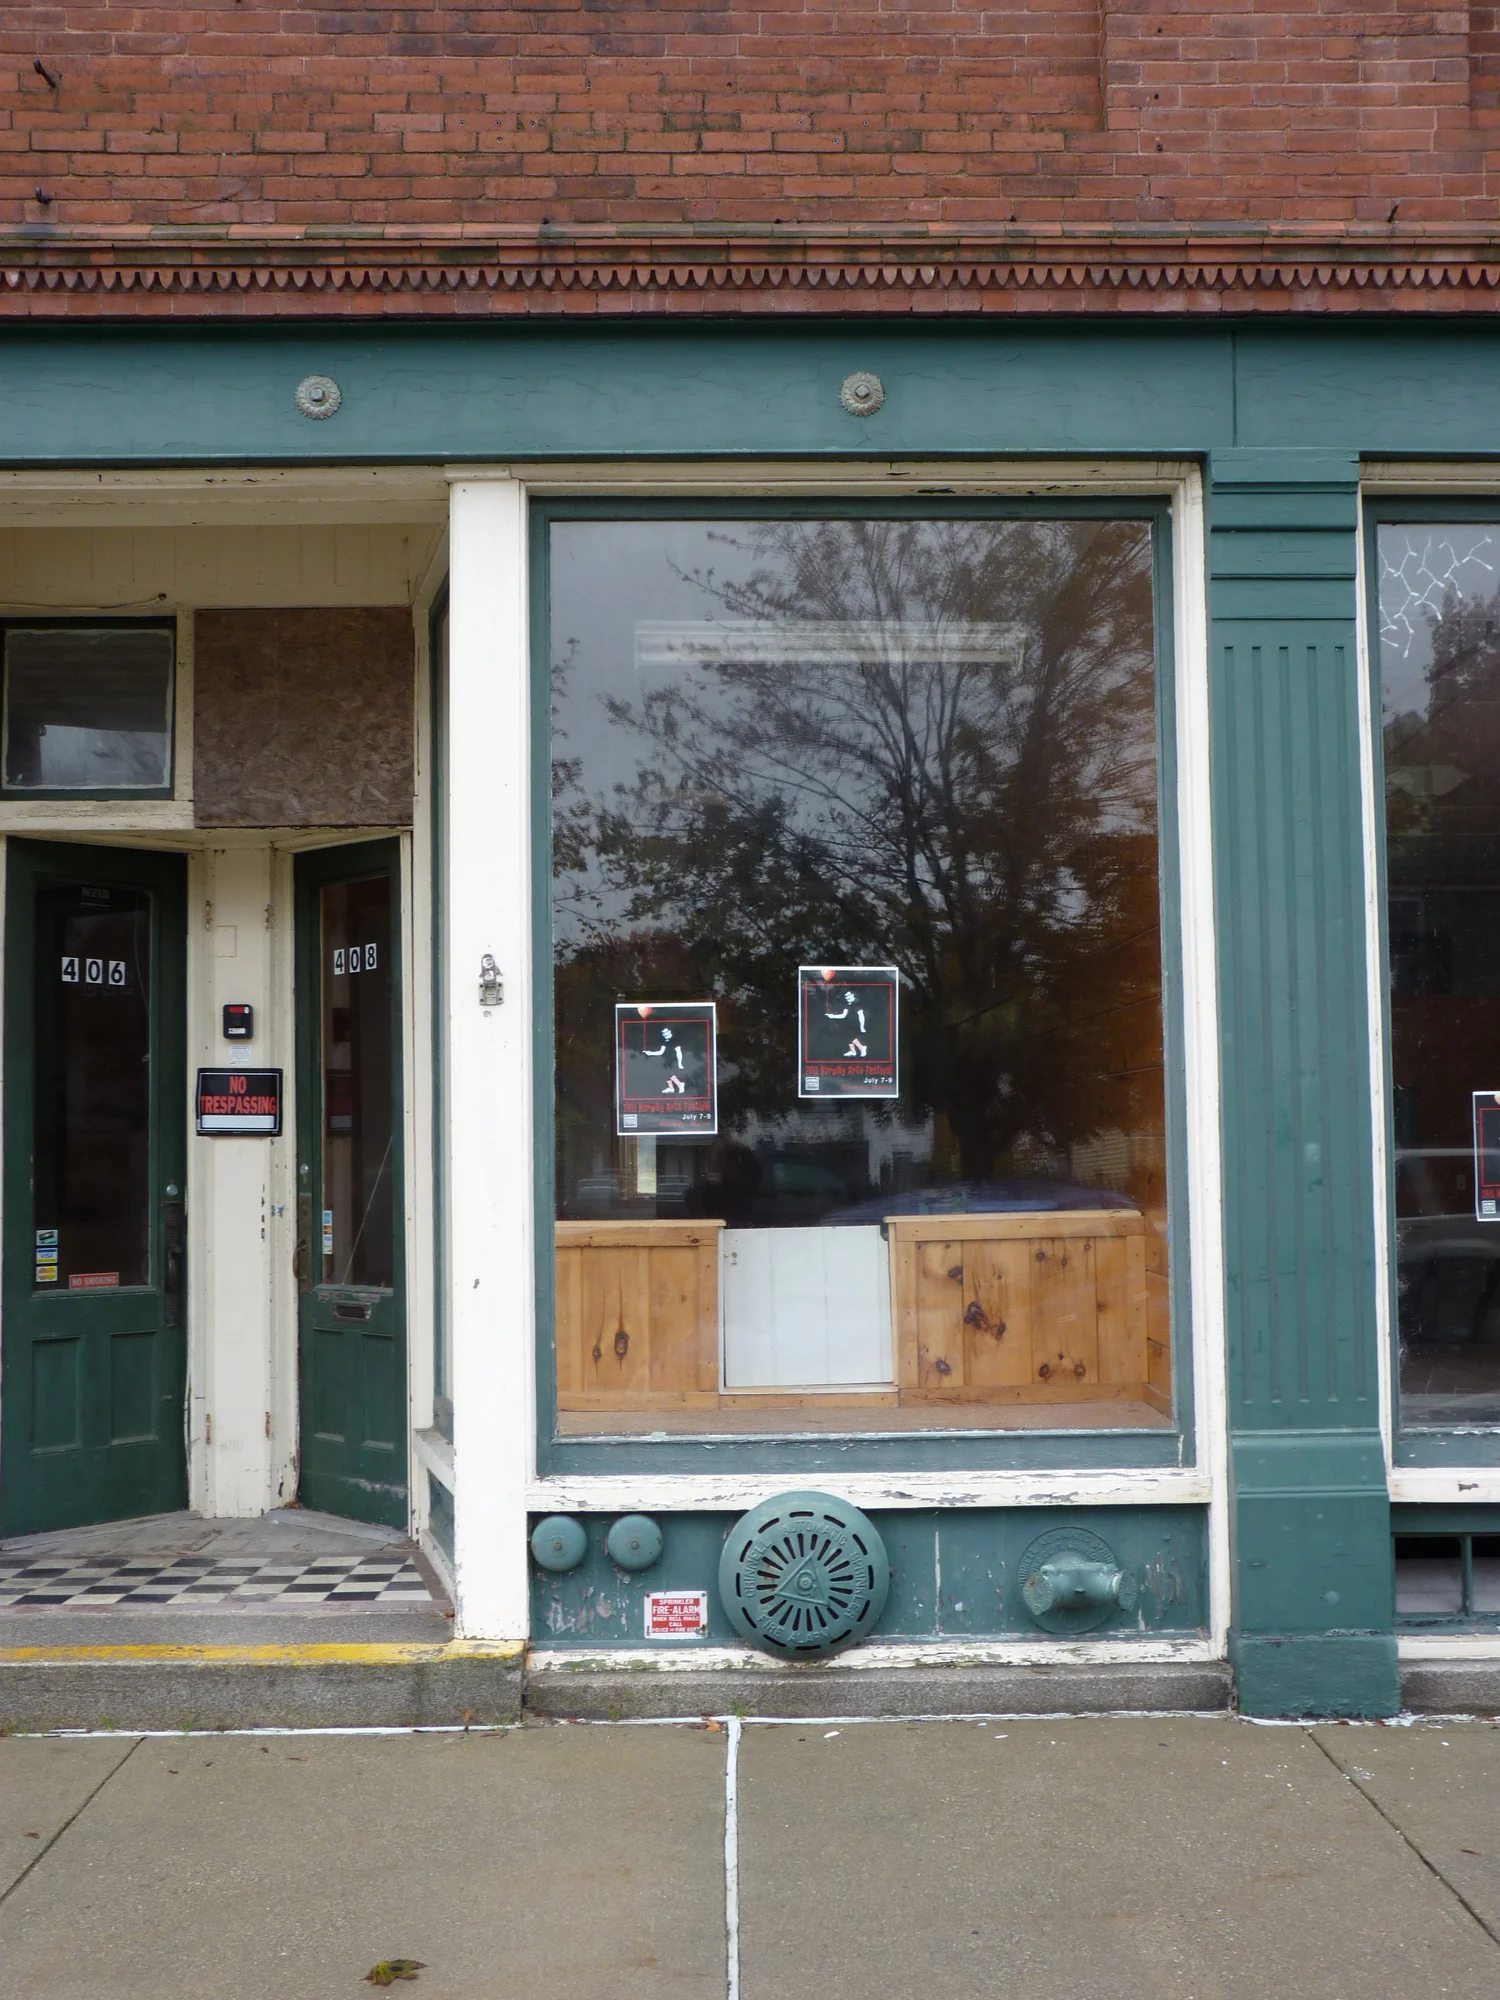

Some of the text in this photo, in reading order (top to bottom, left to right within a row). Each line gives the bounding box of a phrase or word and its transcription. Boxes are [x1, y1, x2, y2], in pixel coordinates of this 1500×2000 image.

[335, 945, 376, 973] 408
[62, 958, 125, 984] 406
[865, 1064, 893, 1076] Festival
[229, 1076, 247, 1094] NO
[201, 1096, 277, 1114] TRESPASSING
[684, 1101, 712, 1111] Festival
[71, 1275, 116, 1287] NO SMOKING
[743, 1521, 868, 1620] GRINNELL AUTOMATIC SPRINKLER
[653, 1605, 700, 1615] FIRE-ALARM
[756, 1613, 830, 1643] FIRE ALARM
